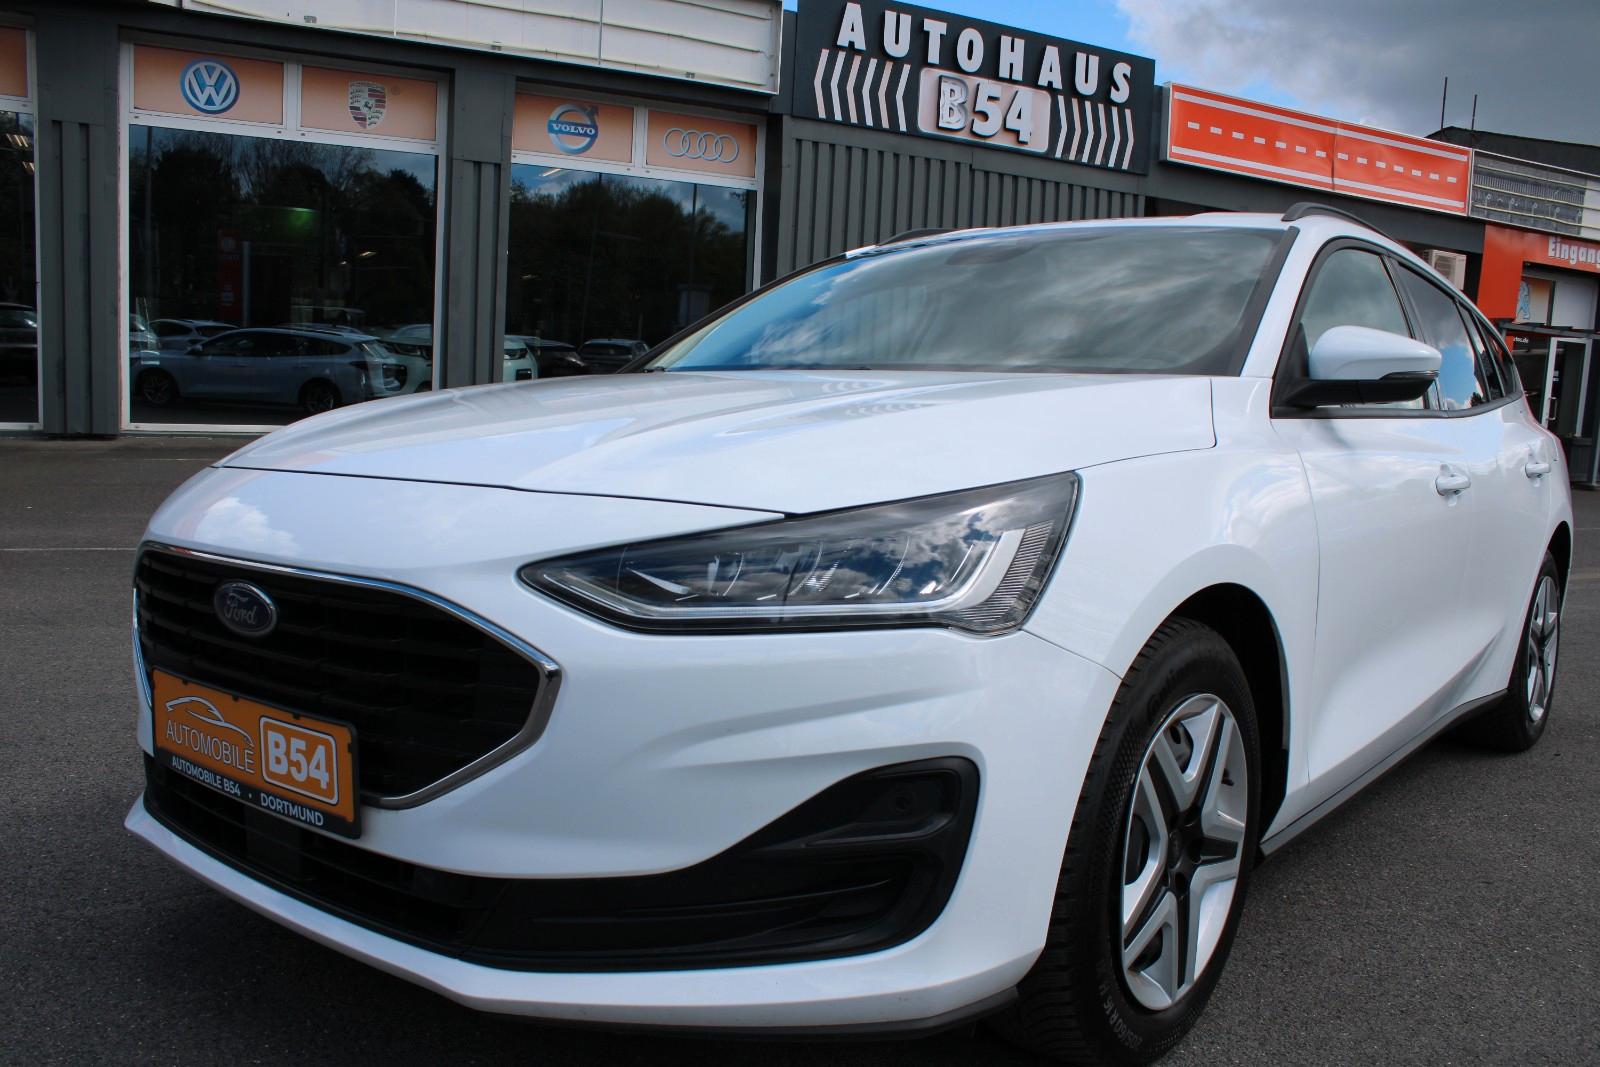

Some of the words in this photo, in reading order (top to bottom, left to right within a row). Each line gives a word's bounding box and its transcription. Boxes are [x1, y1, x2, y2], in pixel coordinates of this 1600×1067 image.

[836, 2, 1133, 104] AUTOHAUS
[552, 123, 596, 135] VOLVO
[937, 74, 1035, 145] B54
[223, 592, 257, 625] Ford
[166, 719, 256, 775] AUTOMOBILE
[267, 730, 329, 790] B54
[172, 755, 222, 790] AUTOMOBILE
[223, 777, 241, 797] B54
[260, 792, 324, 827] DORTMUND
